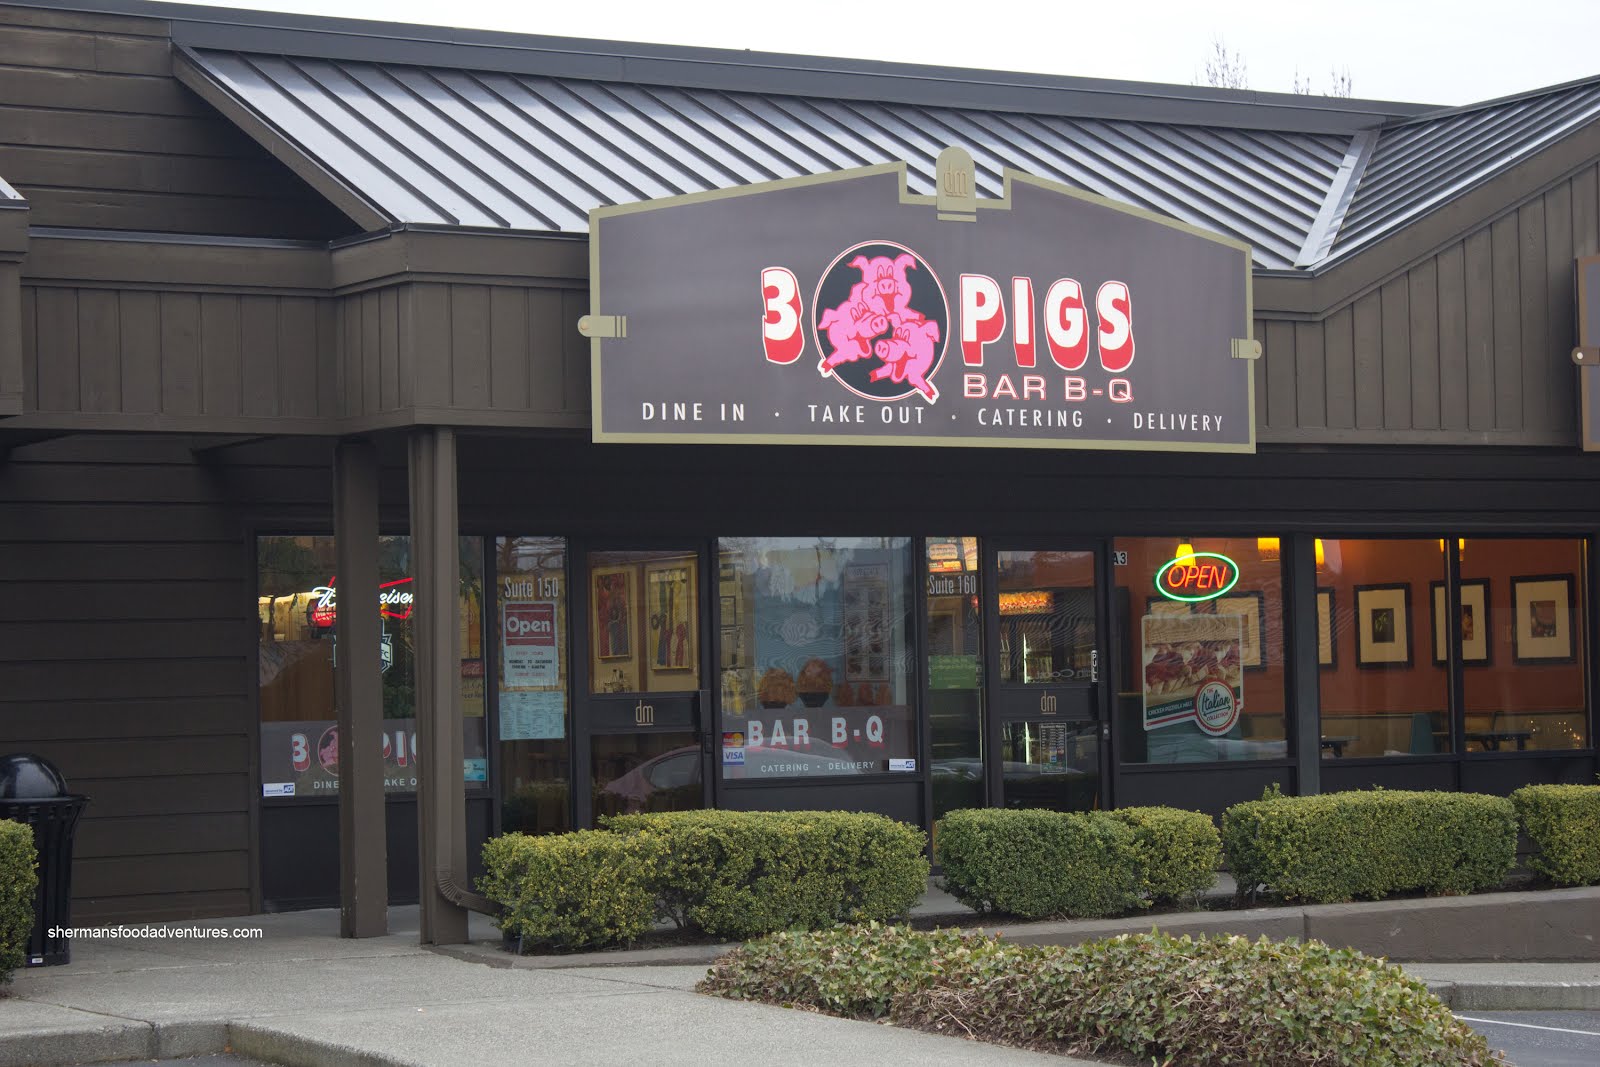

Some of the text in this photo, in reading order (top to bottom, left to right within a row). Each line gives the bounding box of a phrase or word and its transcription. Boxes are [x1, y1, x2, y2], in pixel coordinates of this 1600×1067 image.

[761, 266, 1135, 372] 3 PIGS
[963, 373, 1134, 403] BAR B-Q
[642, 402, 1223, 431] DINE IN TAKE OUT CATERING DELIVERY
[505, 576, 559, 598] Suite 150
[930, 575, 976, 595] Suite 160
[1167, 564, 1227, 589] OPEN
[506, 616, 551, 636] Open
[636, 700, 653, 723] dm
[1041, 690, 1056, 712] dm
[1202, 689, 1230, 713] Italian
[1206, 711, 1229, 721] COLLECTION
[748, 718, 811, 749] BAR
[292, 733, 310, 771] 3
[761, 761, 874, 773] CATERING DELIVERY
[314, 780, 339, 789] DINE
[384, 778, 404, 787] AKE
